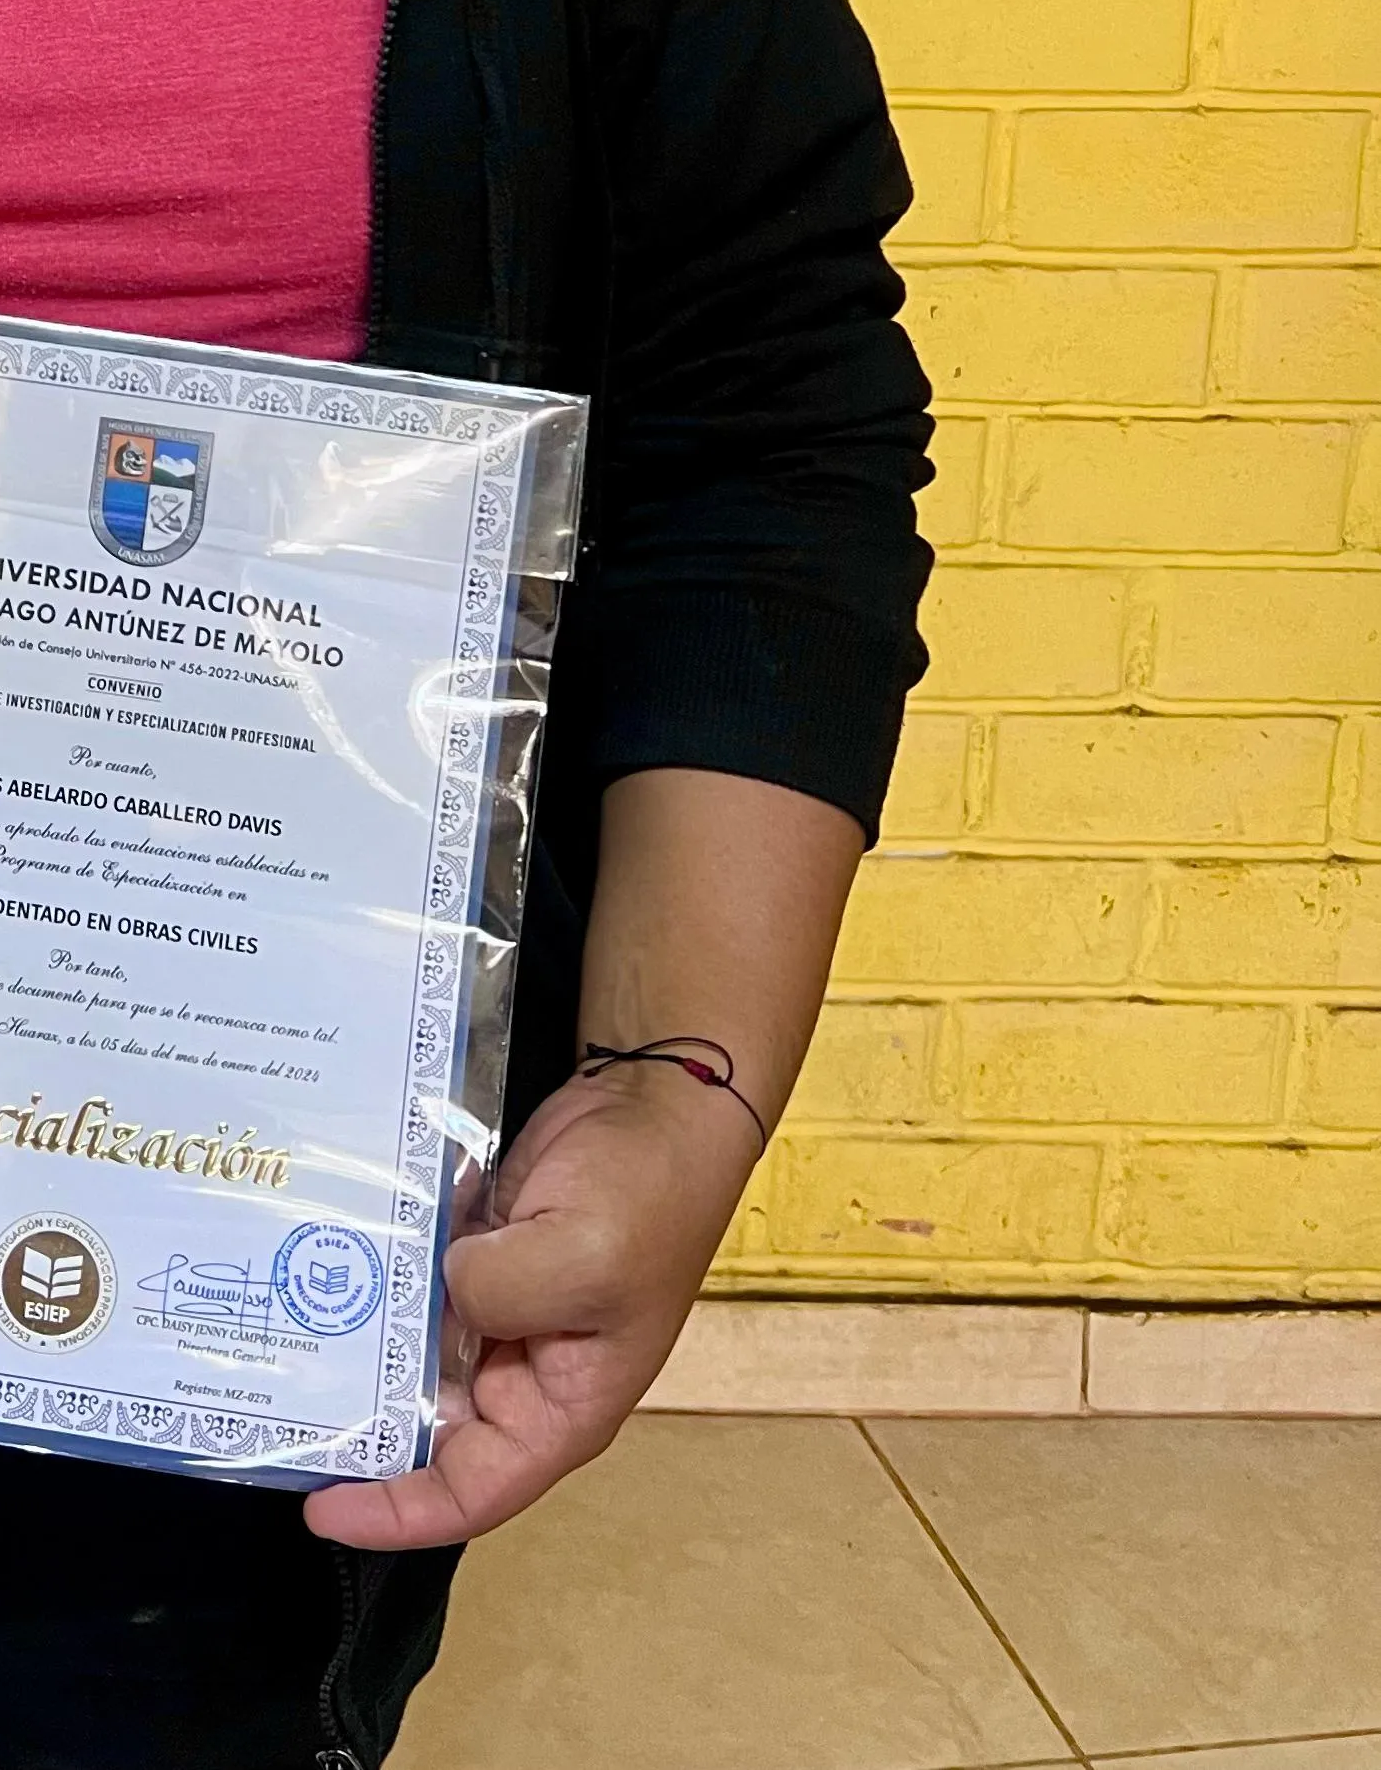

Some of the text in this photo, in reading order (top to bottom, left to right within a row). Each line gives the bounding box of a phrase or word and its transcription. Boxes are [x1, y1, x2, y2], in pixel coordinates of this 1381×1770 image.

[118, 546, 166, 564] UNASAM
[161, 581, 322, 628] NACIONAL
[63, 606, 187, 645] ANTÚNEZ
[194, 625, 227, 651] DE
[18, 638, 34, 650] de
[37, 640, 82, 659] Consejo
[85, 647, 157, 669] Universitario
[87, 676, 162, 699] CONVENIO
[5, 692, 101, 720] INVESTIGACIÓN
[105, 707, 114, 722] Y
[116, 709, 227, 739] ESPECIALIZACIÓN
[230, 727, 317, 753] PROFESIONAL
[68, 744, 157, 780] Por cuanto,
[6, 779, 108, 810] ABELARDO
[113, 795, 222, 827] CABALLERO
[227, 812, 282, 837] DAVIS
[75, 860, 95, 878] de
[101, 858, 223, 898] Especialización
[227, 890, 247, 902] en
[86, 911, 111, 932] EN
[117, 916, 182, 943] OBRAS
[187, 927, 258, 955] CIVILES
[47, 948, 128, 983] Por tanto,
[24, 1301, 71, 1323] ESIEP
[161, 1316, 194, 1333] DAISY
[193, 1323, 229, 1339] JENNY
[229, 1327, 278, 1349] CAMPOO
[279, 1336, 319, 1353] ZAPATA
